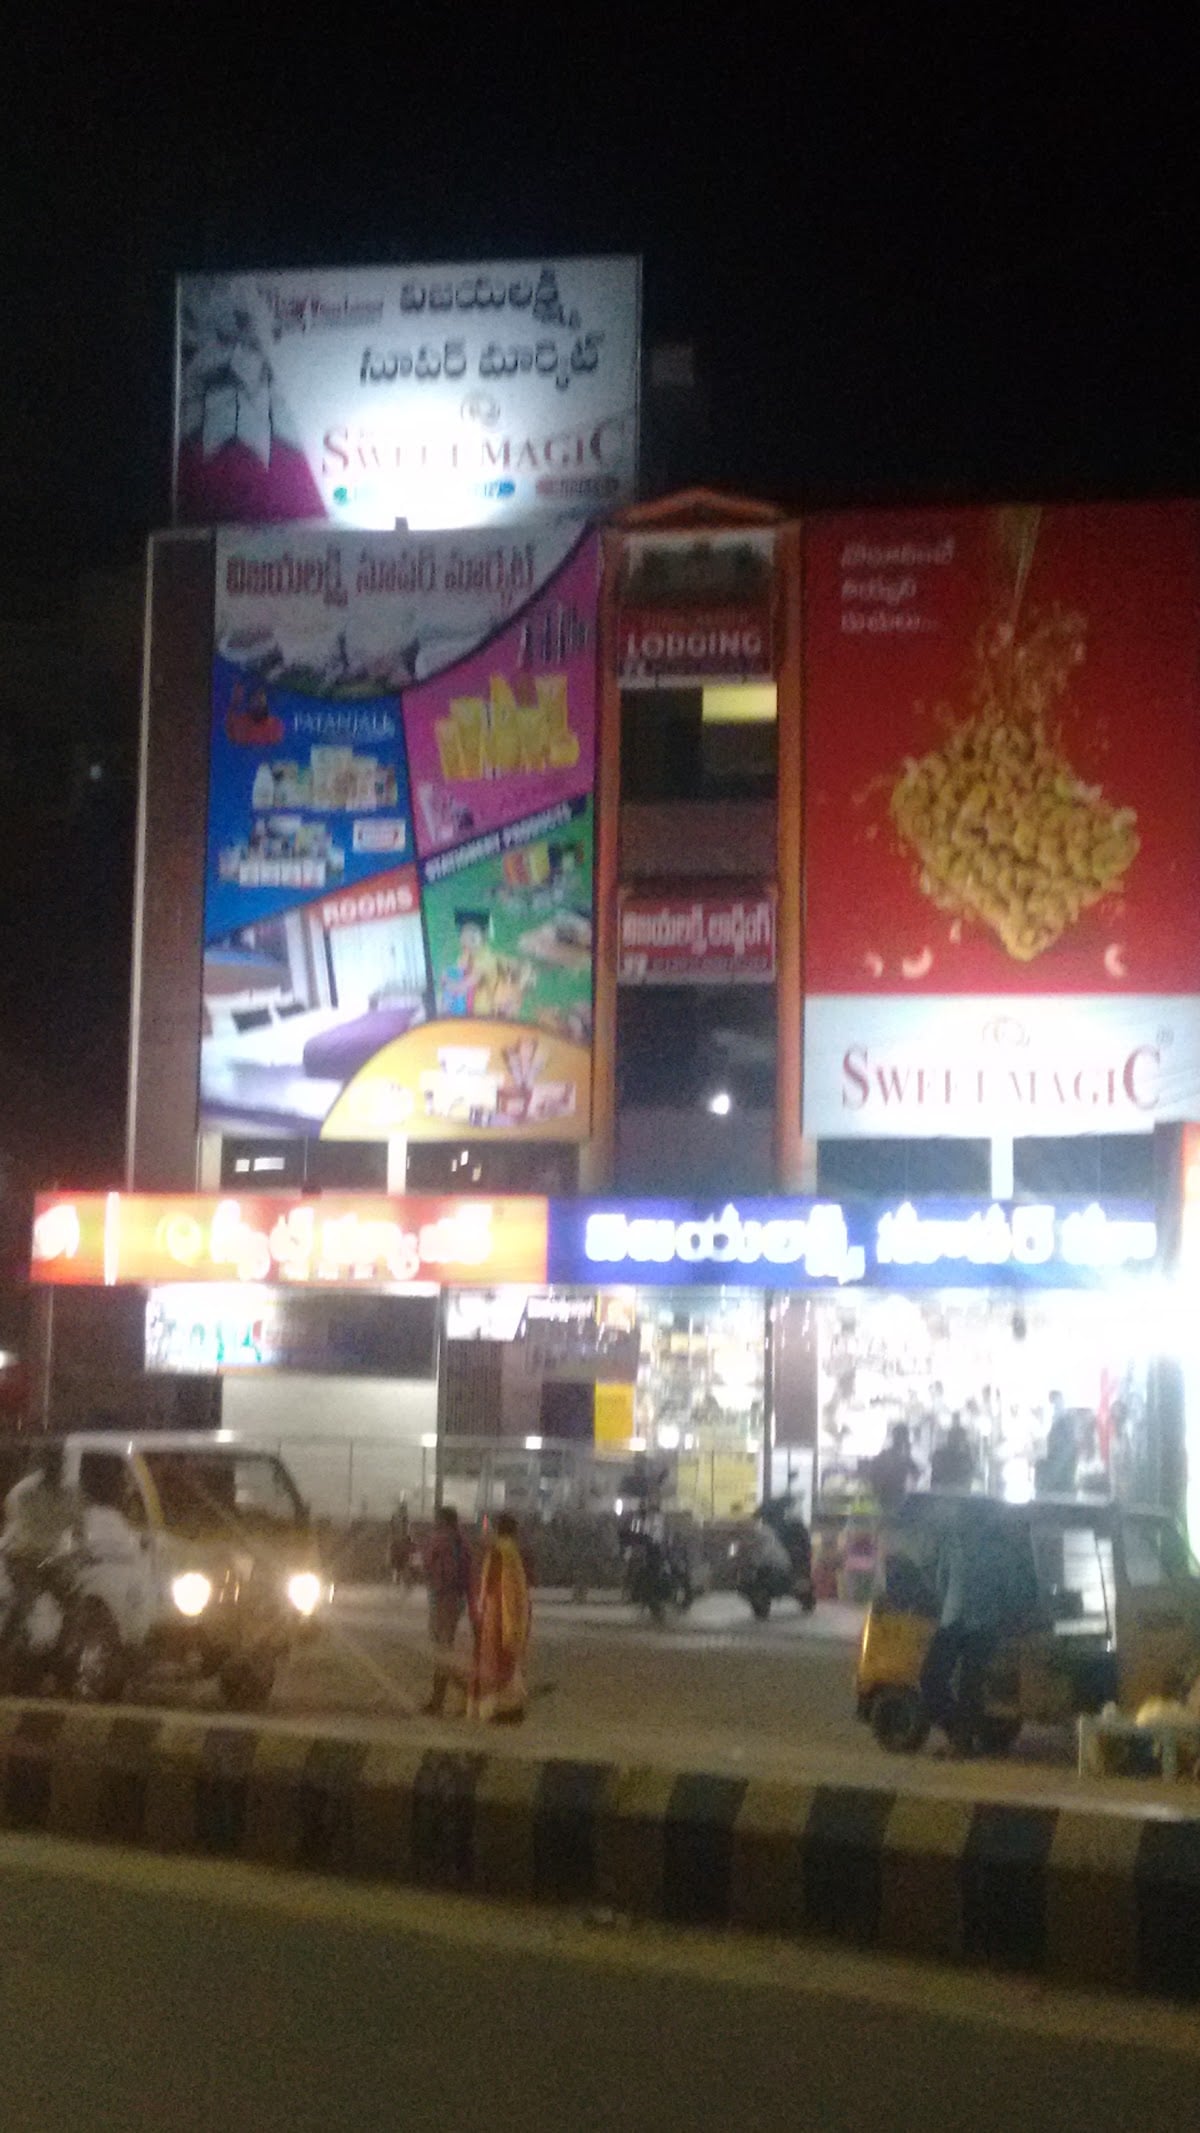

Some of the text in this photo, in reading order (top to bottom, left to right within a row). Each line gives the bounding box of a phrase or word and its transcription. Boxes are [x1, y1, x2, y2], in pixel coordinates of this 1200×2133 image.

[479, 417, 627, 473] MAGIC
[626, 629, 763, 661] LODGING
[322, 885, 414, 928] ROOMS
[1008, 1043, 1162, 1111] MAGIC
